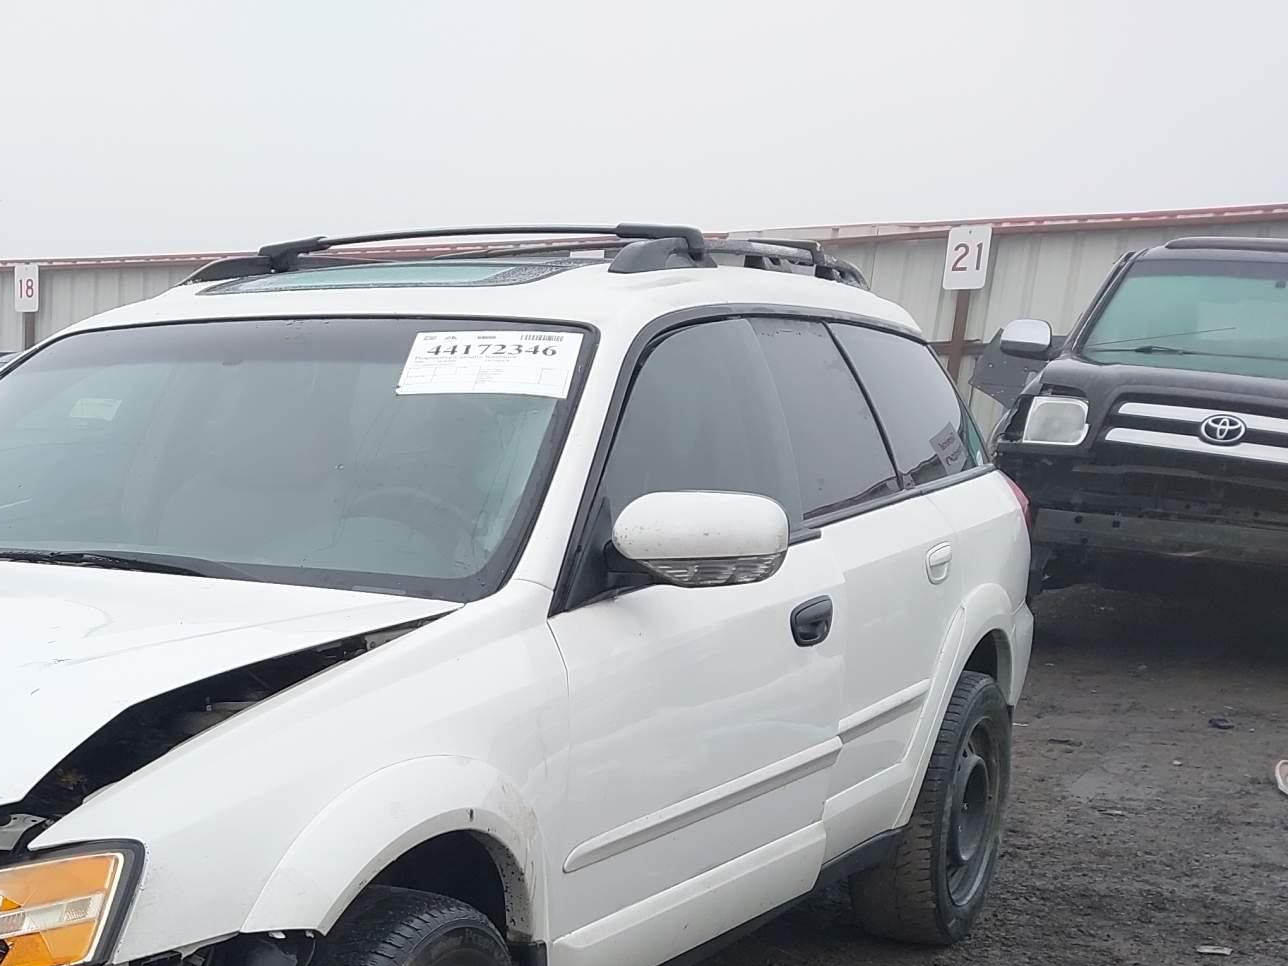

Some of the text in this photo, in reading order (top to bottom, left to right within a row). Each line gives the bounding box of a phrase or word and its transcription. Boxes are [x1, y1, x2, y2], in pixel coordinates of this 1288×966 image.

[951, 242, 983, 271] 21
[19, 279, 34, 299] 18
[426, 343, 558, 356] 44172346
